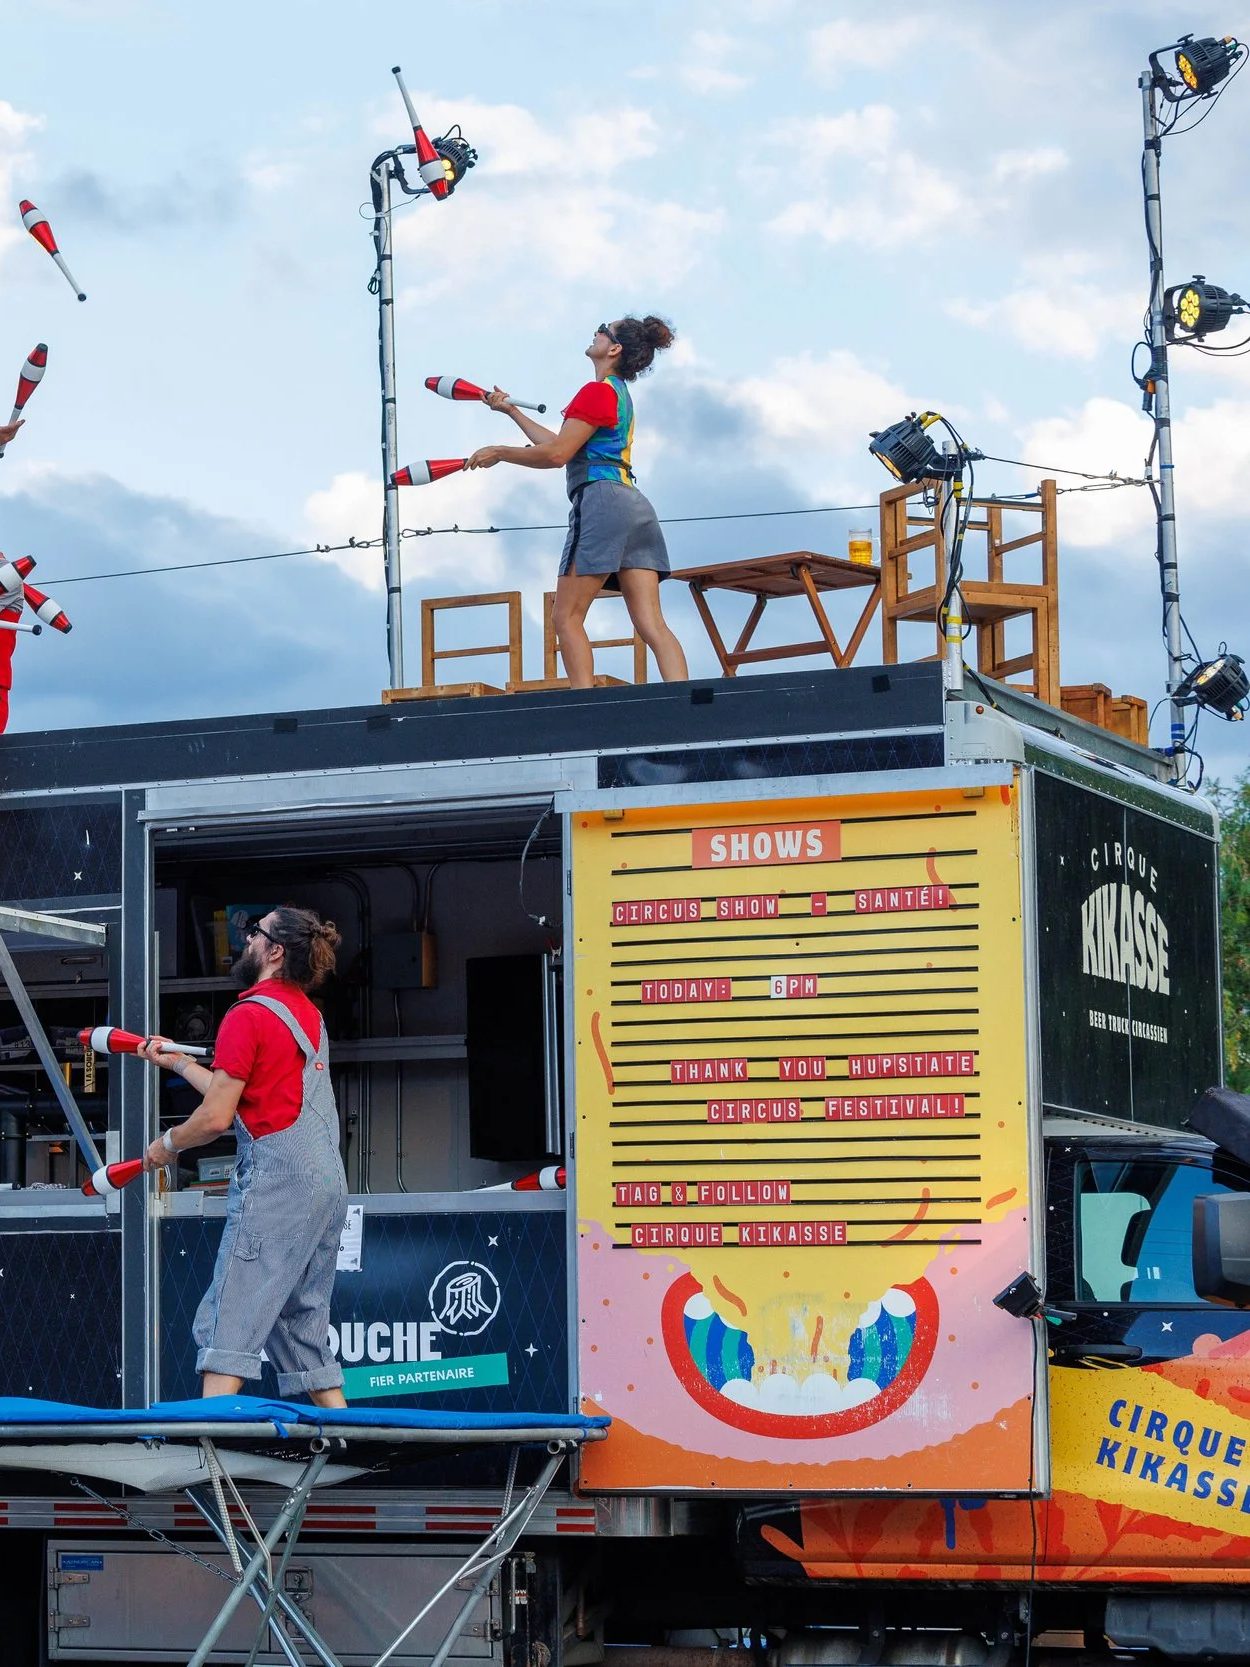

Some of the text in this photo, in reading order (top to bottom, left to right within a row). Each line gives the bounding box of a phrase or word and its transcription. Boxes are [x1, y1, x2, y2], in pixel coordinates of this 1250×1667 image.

[710, 829, 823, 862] SHOWS
[1090, 842, 1158, 893] CIRQUE
[615, 903, 698, 922] CIRCUS
[720, 898, 777, 917] SHOW
[858, 888, 944, 909] SANTÉ!
[1081, 882, 1170, 996] KIKASSE
[644, 979, 814, 1000] TODAY: 6PM
[1089, 1010, 1168, 1044] BEER TRUCK CIRCASSIEN
[674, 1055, 971, 1081] THANK YOU HUPSTATE
[710, 1098, 960, 1121] CIRCUS FESTIVAL!
[620, 1184, 788, 1203] TAG & FOLLOW
[635, 1226, 843, 1244] CIRQUE KIKASSE
[370, 1367, 474, 1387] FIER PARTENAIRE
[1108, 1399, 1246, 1467] CIRQUE
